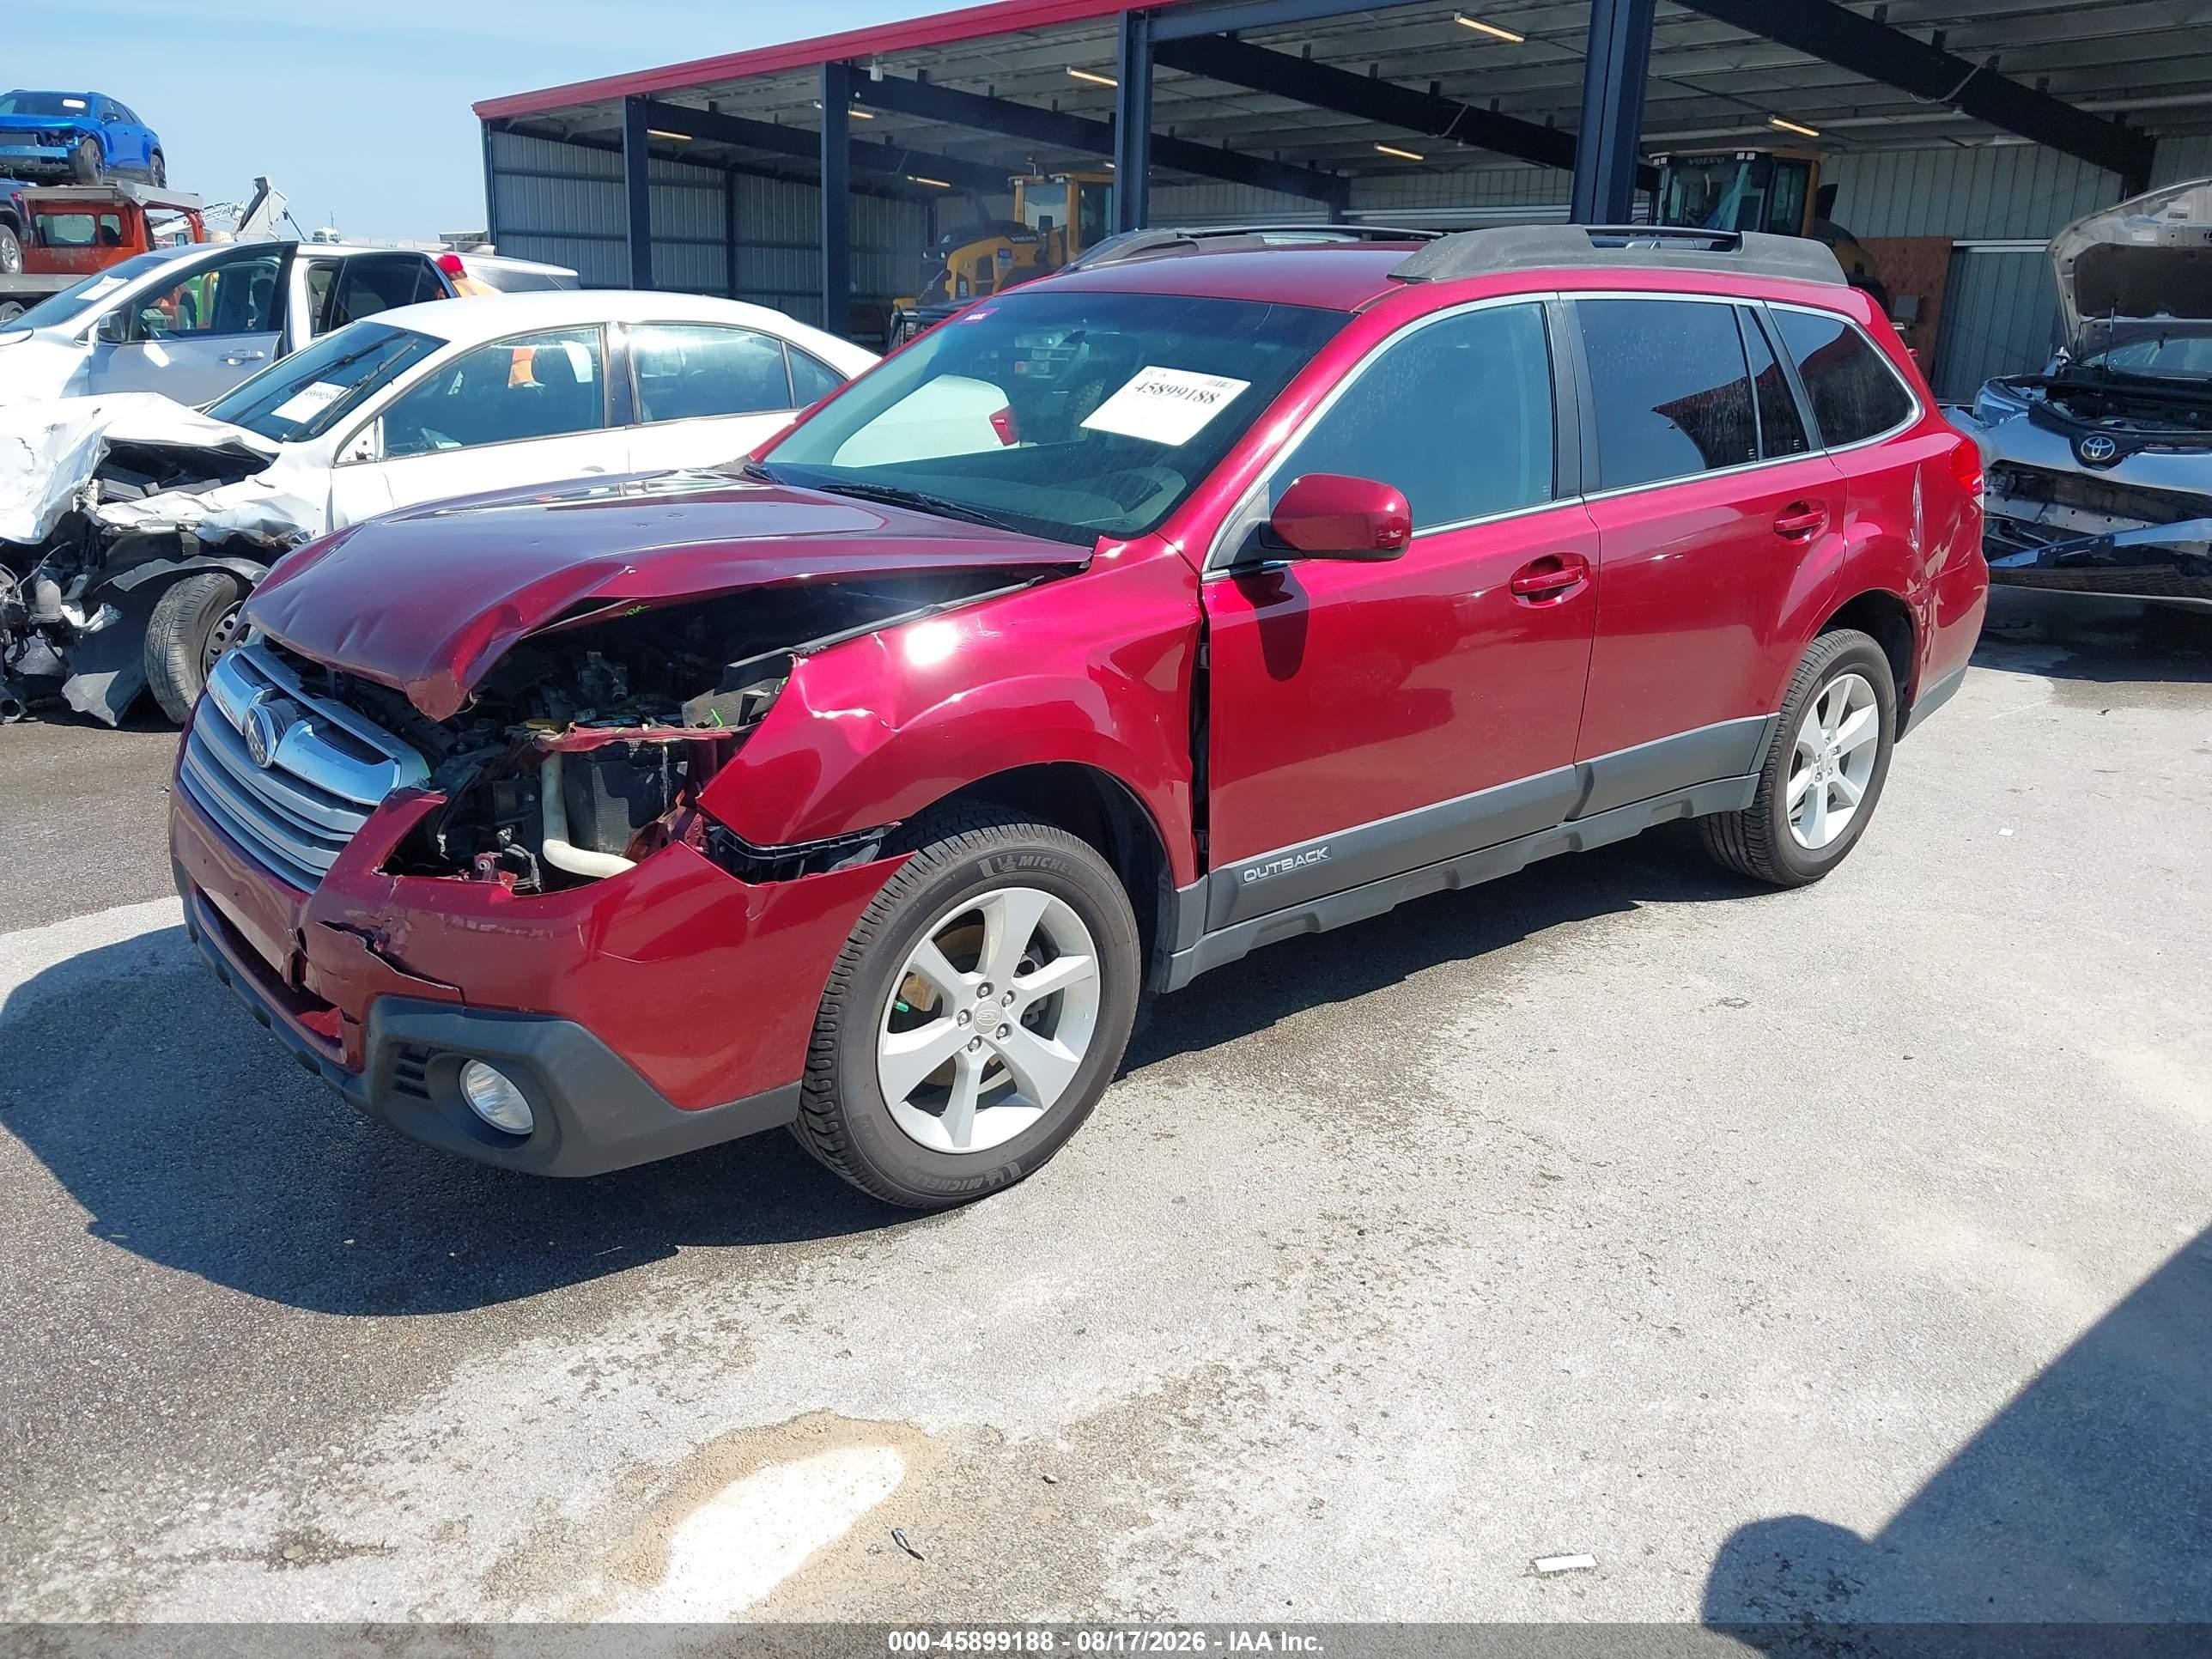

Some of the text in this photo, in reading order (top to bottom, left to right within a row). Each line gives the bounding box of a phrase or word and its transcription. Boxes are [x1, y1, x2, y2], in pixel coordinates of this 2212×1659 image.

[1688, 156, 1725, 165] VOLVO
[1134, 381, 1220, 404] 45899188
[1018, 855, 1085, 878] MICHEL
[1243, 846, 1328, 883] OUTBACK
